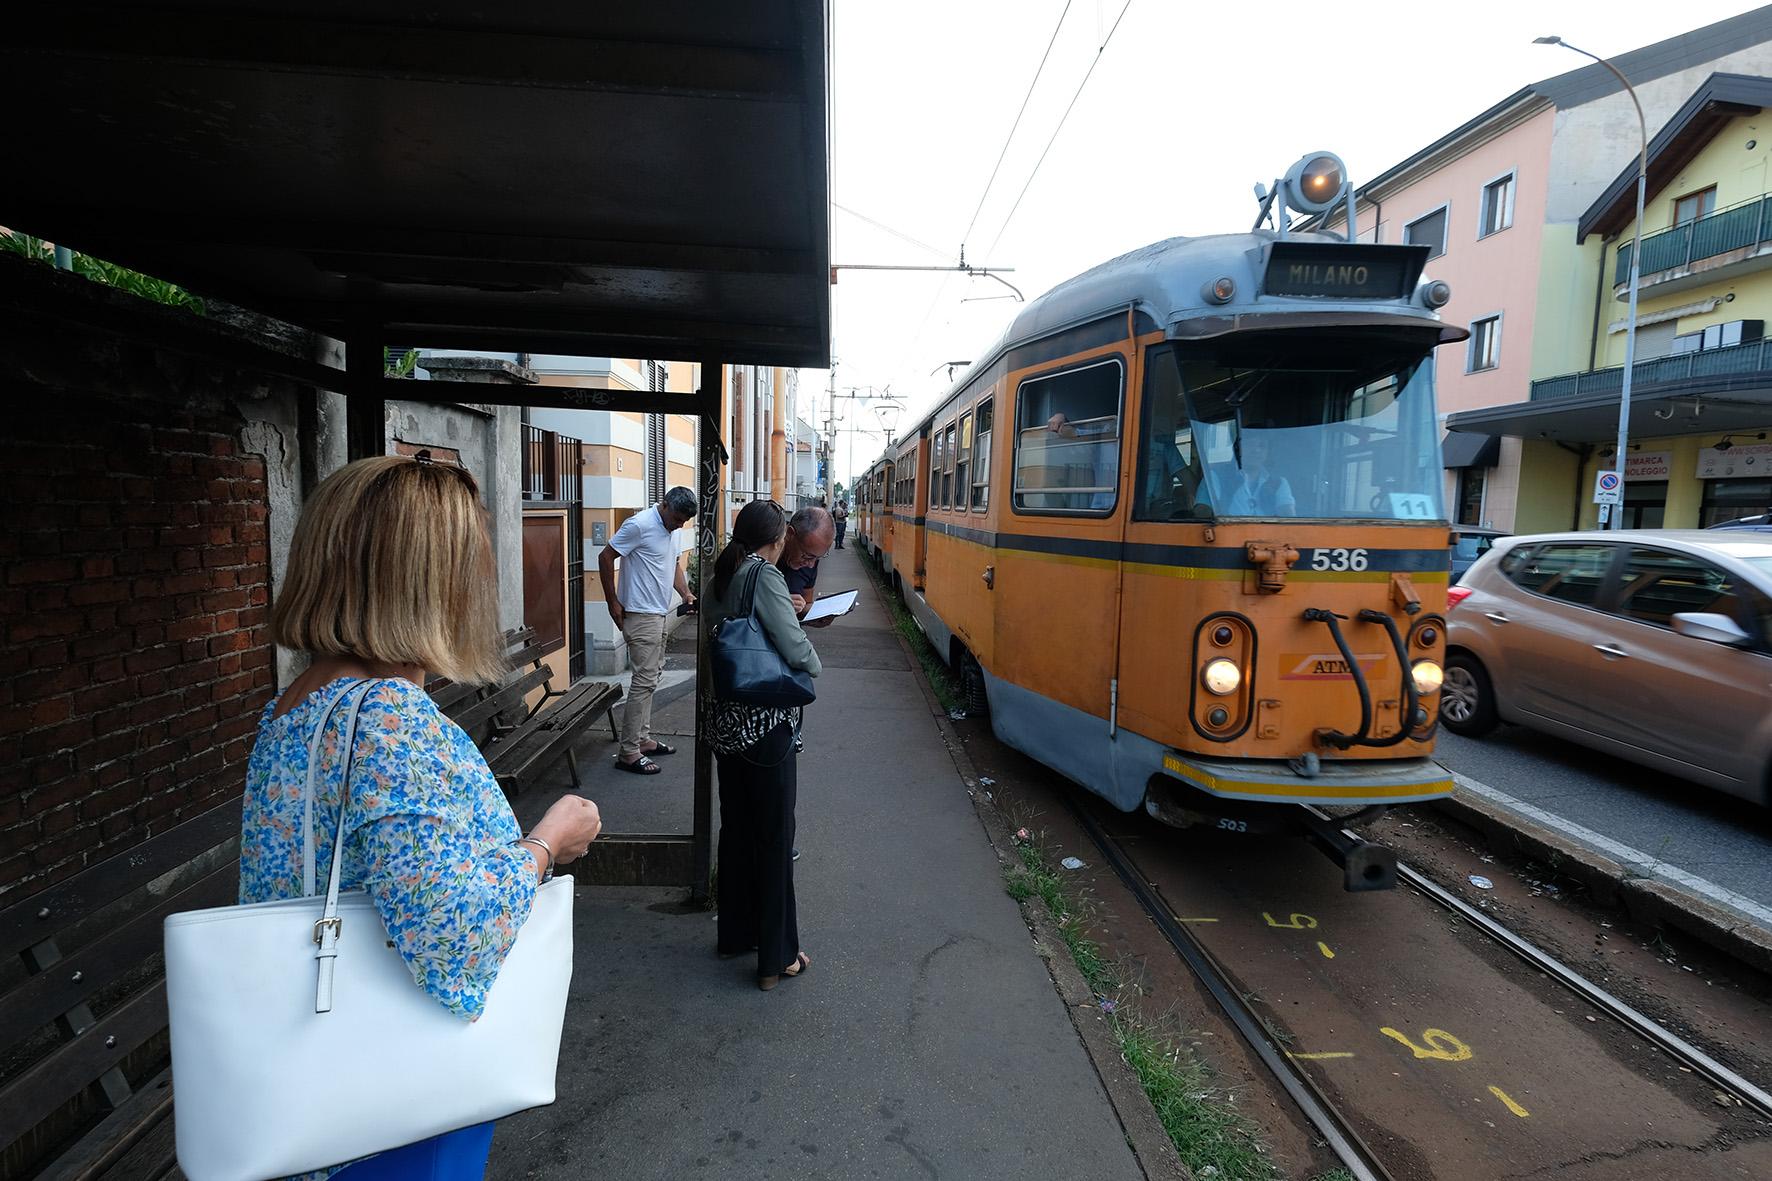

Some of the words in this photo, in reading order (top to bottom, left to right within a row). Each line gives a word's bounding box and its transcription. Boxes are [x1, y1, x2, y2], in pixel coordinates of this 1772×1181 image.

[1288, 265, 1368, 285] MILANO
[1401, 500, 1429, 516] 11
[1312, 549, 1368, 571] 536
[1312, 660, 1353, 674] ATM
